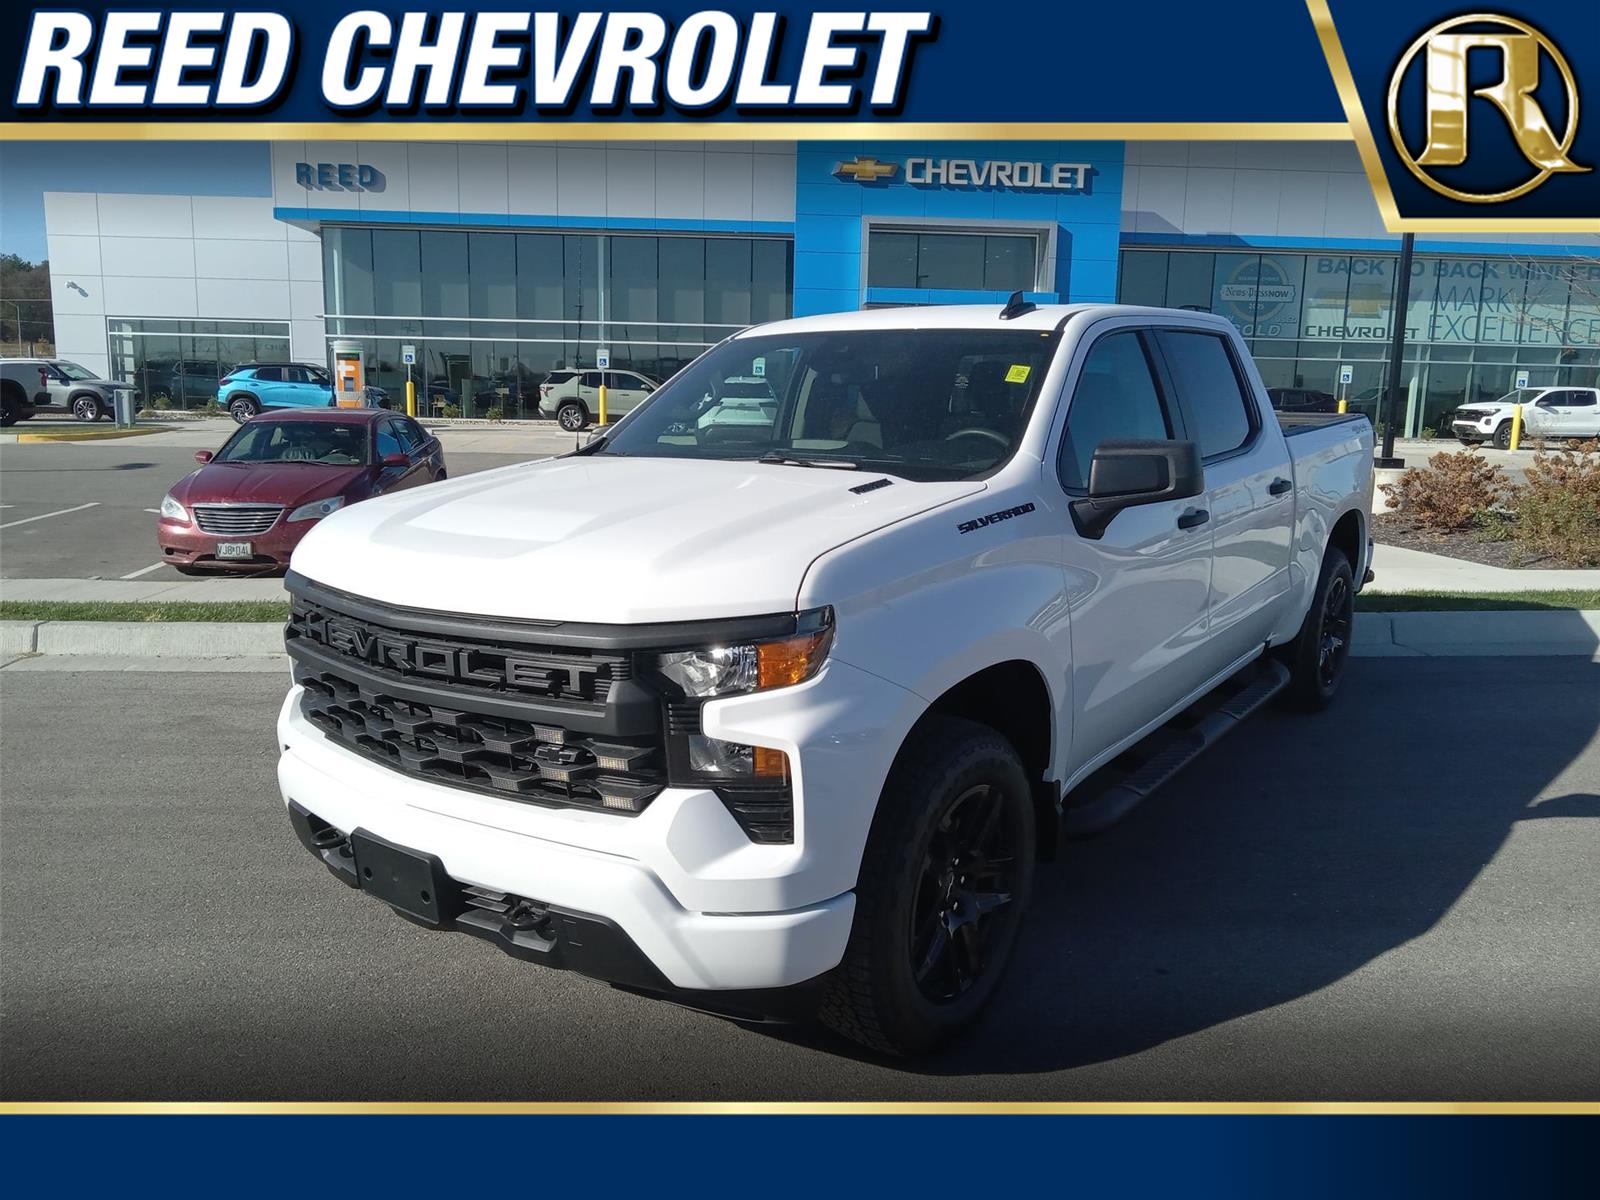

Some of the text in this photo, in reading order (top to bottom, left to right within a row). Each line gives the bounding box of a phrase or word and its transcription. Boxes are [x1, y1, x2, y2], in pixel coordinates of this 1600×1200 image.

[295, 162, 373, 188] REED
[904, 157, 1092, 189] CHEVROLET
[1317, 258, 1385, 275] BACK
[1432, 262, 1500, 280] BACK
